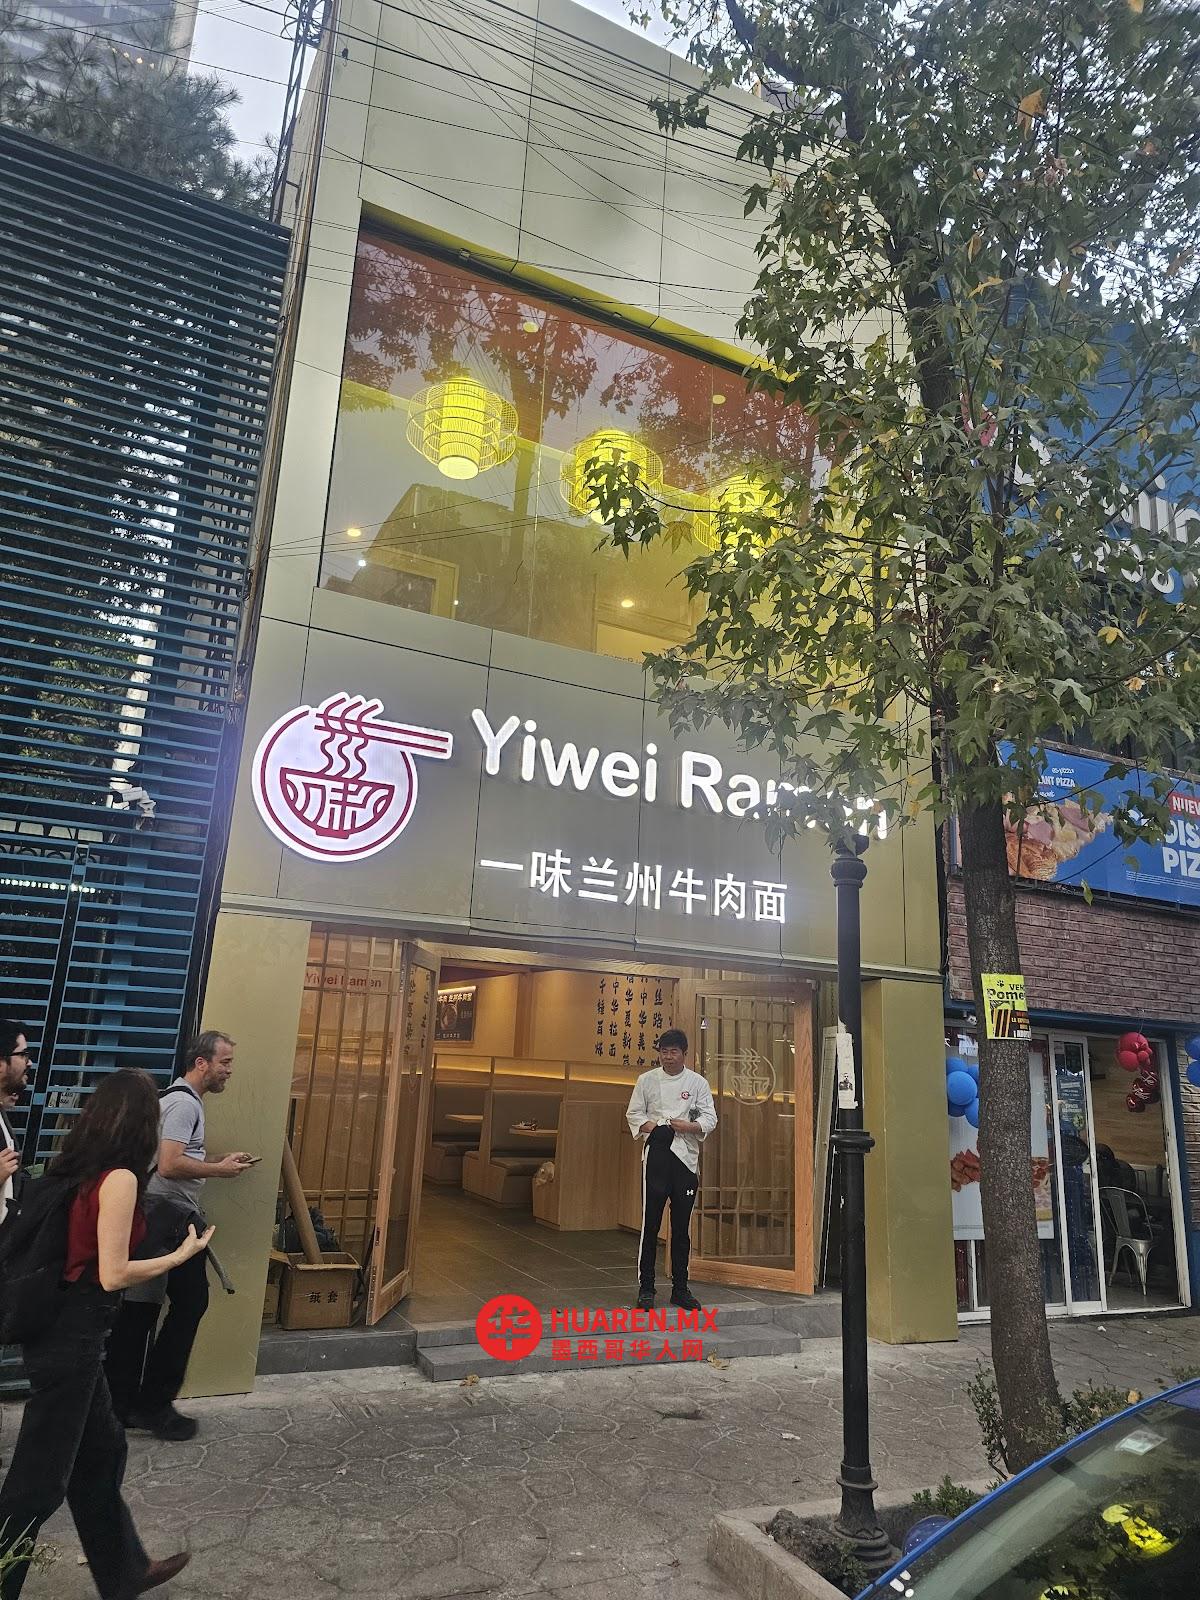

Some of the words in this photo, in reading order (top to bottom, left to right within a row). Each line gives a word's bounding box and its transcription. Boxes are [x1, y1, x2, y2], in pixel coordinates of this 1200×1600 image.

[471, 708, 658, 803] Yiwei
[1055, 777, 1076, 788] PIZZA
[479, 849, 788, 924] 一味兰州牛肉面
